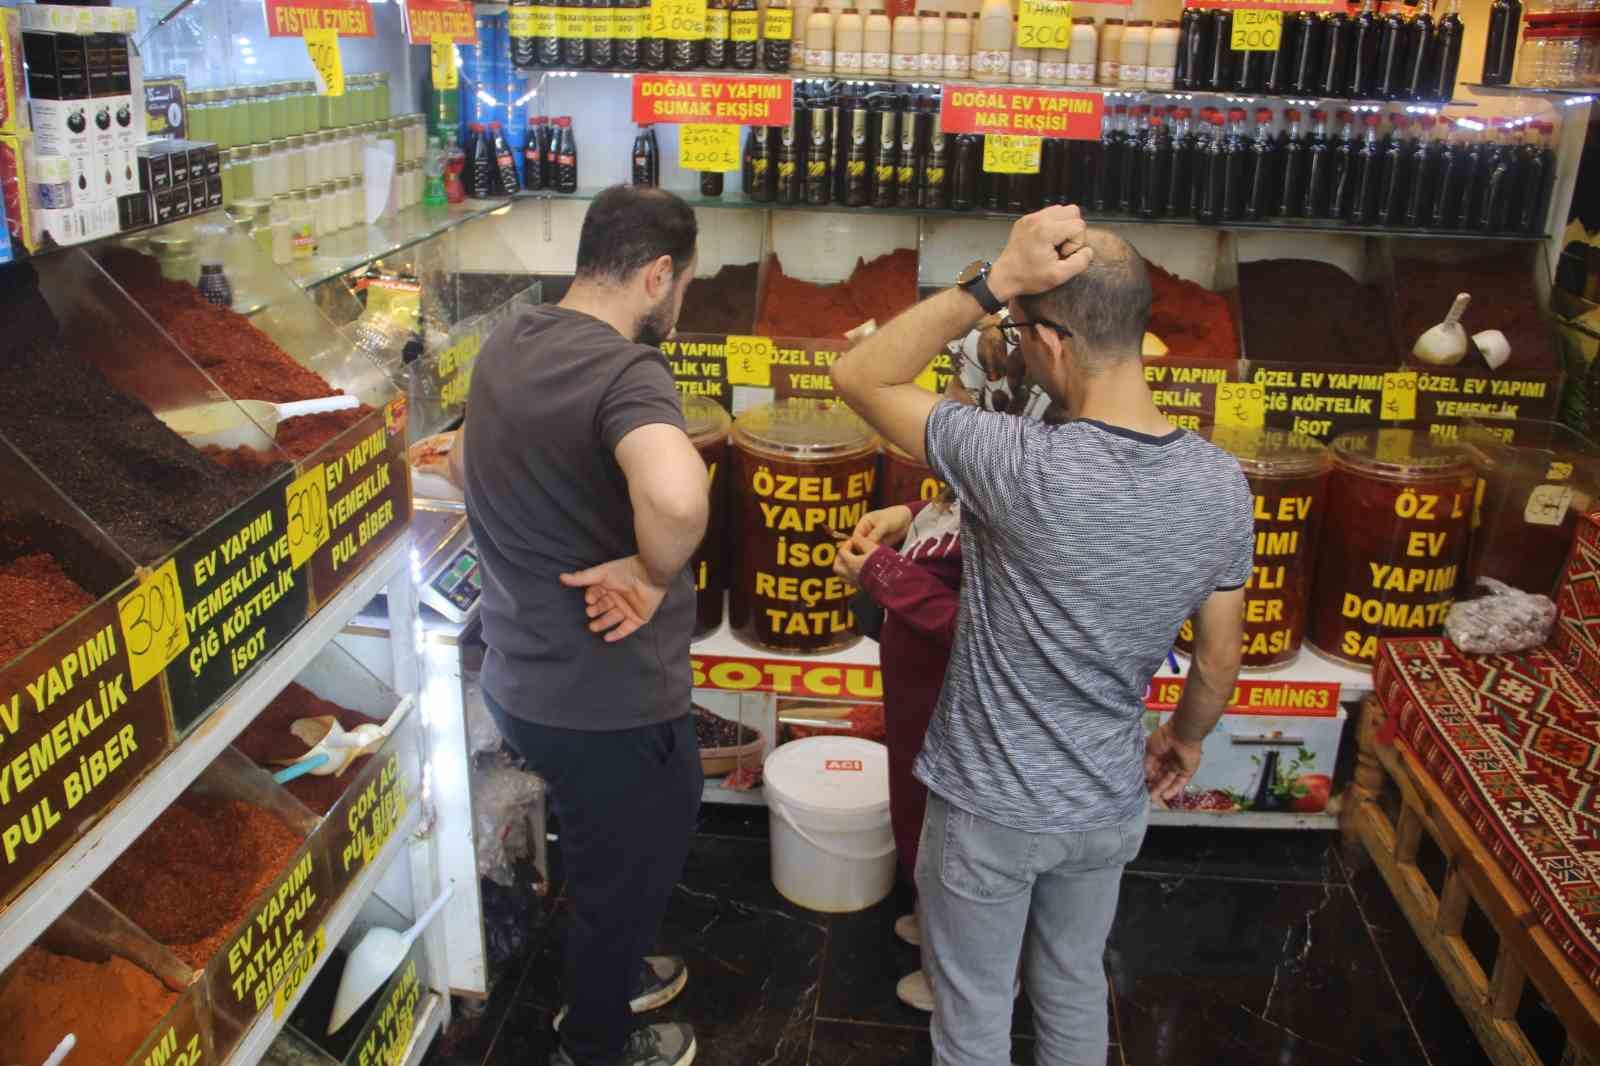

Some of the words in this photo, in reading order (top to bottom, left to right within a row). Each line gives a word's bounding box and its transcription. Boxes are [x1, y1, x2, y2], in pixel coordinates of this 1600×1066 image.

[1021, 25, 1066, 44] 300
[1233, 30, 1275, 47] 300
[641, 80, 697, 97] DOĞAL
[701, 83, 723, 98] EV
[727, 84, 782, 99] YAPIMI
[951, 90, 1007, 109] DOĞAL
[1011, 96, 1034, 110] EV
[1038, 97, 1094, 114] YAPIMI
[653, 101, 711, 116] SUMAK
[716, 100, 769, 120] EKŞİSİ
[975, 112, 1008, 127] NAR
[1013, 113, 1067, 132] EKŞİSİ
[729, 342, 767, 355] 500
[814, 351, 838, 367] EV
[702, 362, 722, 377] VE
[789, 373, 832, 390] YEME
[1143, 366, 1166, 382] EV
[1171, 368, 1226, 385] YAPIMI
[1254, 368, 1296, 387] ÖZEL
[1301, 373, 1323, 388] EV
[1328, 374, 1383, 391] YAPIMI
[1152, 388, 1202, 408] EKLİK
[1220, 386, 1262, 401] 500
[1418, 373, 1459, 393] ÖZEL
[1463, 379, 1488, 394] EV
[1491, 380, 1547, 398] YAPIMI
[1292, 395, 1373, 415] KÖFTELİK
[1294, 416, 1332, 436] İSOT
[326, 457, 345, 492] EV
[345, 426, 387, 475] YAPIMI
[328, 462, 391, 530] YEMEKLİK
[752, 465, 842, 502] ÖZEL
[846, 466, 876, 499] EV
[1277, 496, 1312, 521] EV
[193, 550, 218, 587] EV
[219, 509, 274, 566] YAPIMI
[331, 532, 359, 571] PUL
[358, 499, 394, 547] BİBER
[1406, 531, 1447, 558] EV
[776, 536, 842, 568] İSO
[184, 550, 269, 633] YEMEKLİK
[268, 533, 289, 566] VE
[1368, 561, 1457, 593] YAPIMI
[119, 572, 177, 656] 300
[189, 626, 220, 678] ÇİĞ
[221, 566, 296, 646] KÖFTELİK
[230, 626, 267, 676] İSOT
[0, 694, 19, 745] V
[25, 623, 118, 713] YAPIMI
[1248, 684, 1329, 708] EMİN63
[0, 673, 128, 806] YEMEKLİK
[1, 796, 62, 865] PUL
[62, 723, 139, 810] BİBER
[348, 779, 377, 838] ÇOK
[228, 925, 253, 975] EV
[256, 850, 313, 935] YAPIMI
[232, 925, 281, 1002] TATLI
[284, 886, 317, 936] PUL
[254, 930, 305, 1012] BİBER
